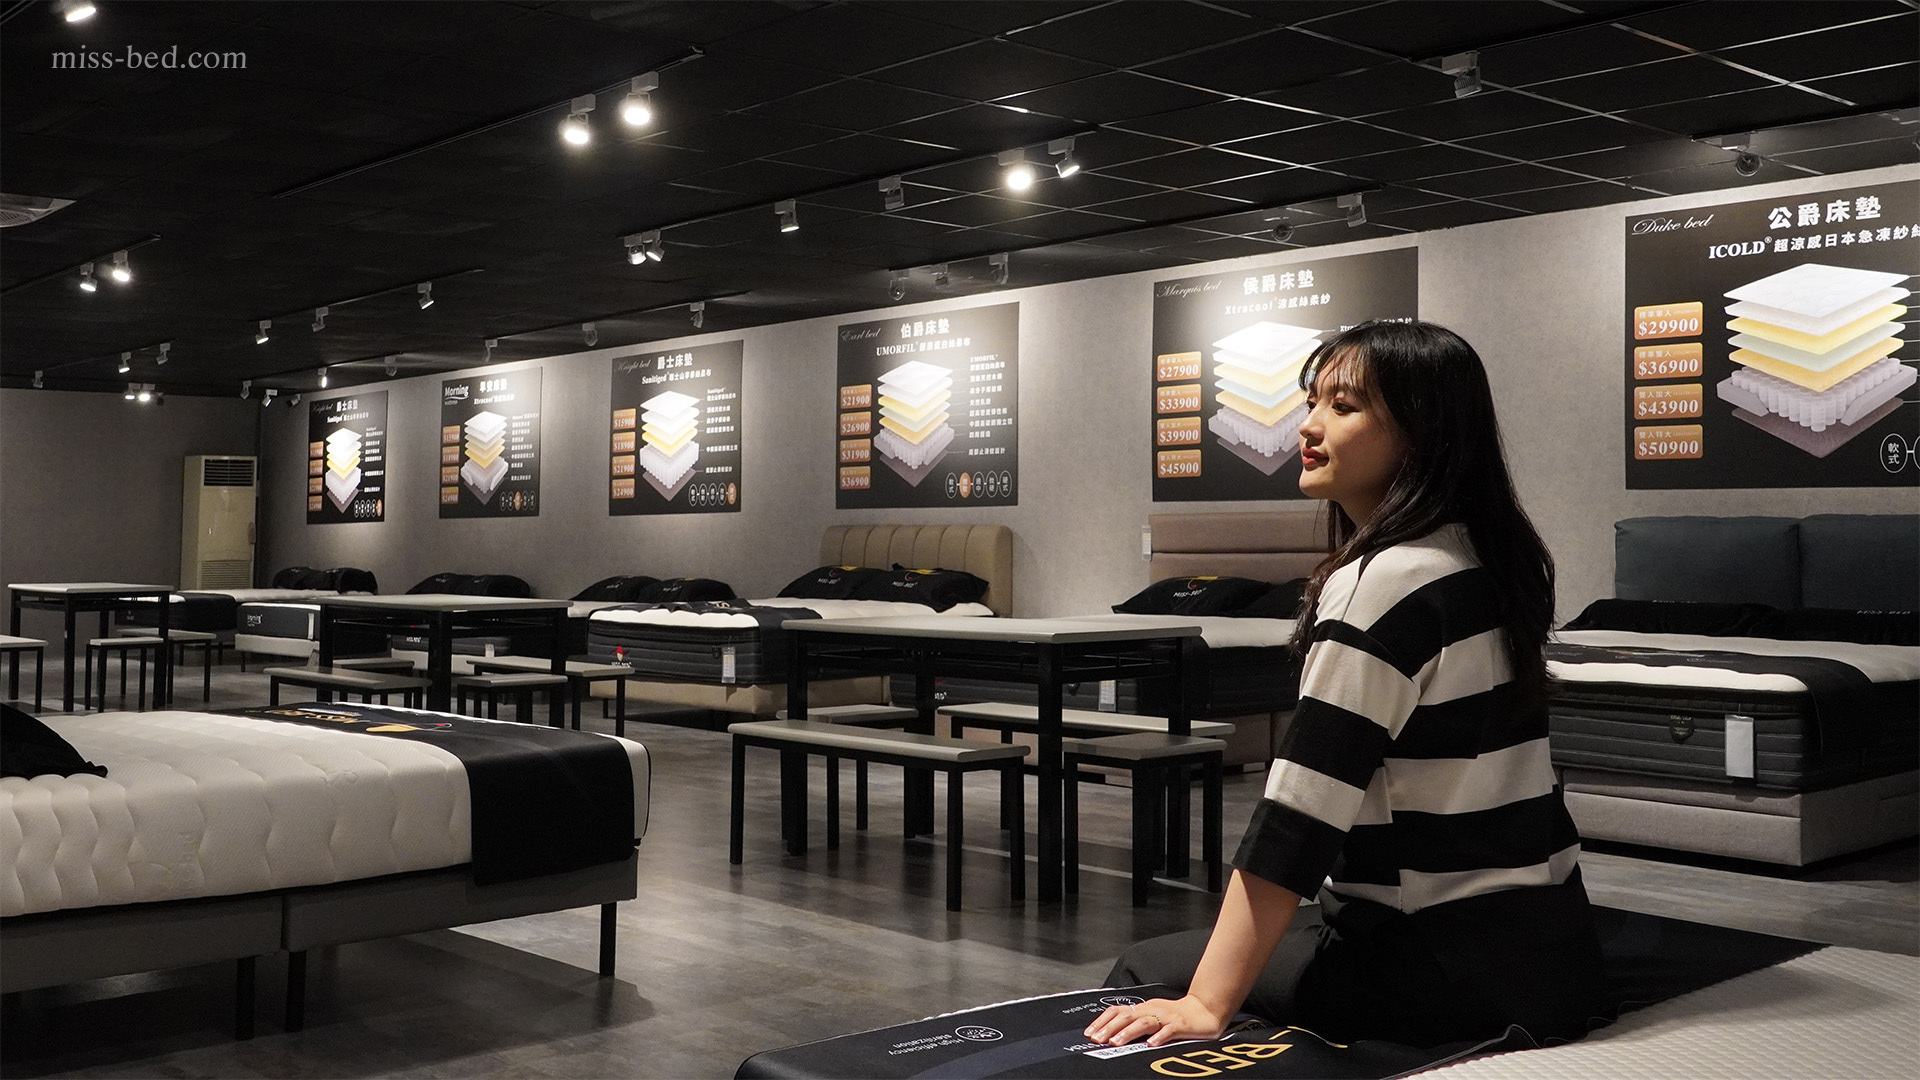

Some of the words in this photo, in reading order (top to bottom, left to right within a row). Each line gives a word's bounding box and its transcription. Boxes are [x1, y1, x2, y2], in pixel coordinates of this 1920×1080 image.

[1768, 196, 1881, 229] 公爵床墊
[1632, 217, 1681, 235] Duke
[1683, 213, 1715, 230] bed
[1243, 269, 1315, 295] 侯爵床墊
[1156, 283, 1201, 298] Marquis
[901, 318, 950, 339] 伯爵床墊
[1638, 317, 1699, 337] $29900
[1160, 364, 1199, 379] $27900
[1638, 358, 1699, 377] $36900
[842, 395, 870, 406] $21900
[1160, 396, 1199, 411] $33900
[1638, 399, 1699, 417] $43900
[842, 422, 870, 433] $26900
[1160, 429, 1199, 443] $39900
[841, 449, 870, 460] $31900
[1638, 440, 1699, 457] $50900
[1888, 442, 1900, 464] 軟式
[1160, 462, 1199, 475] $45900
[841, 477, 869, 488] $36900
[937, 1038, 965, 1046] High
